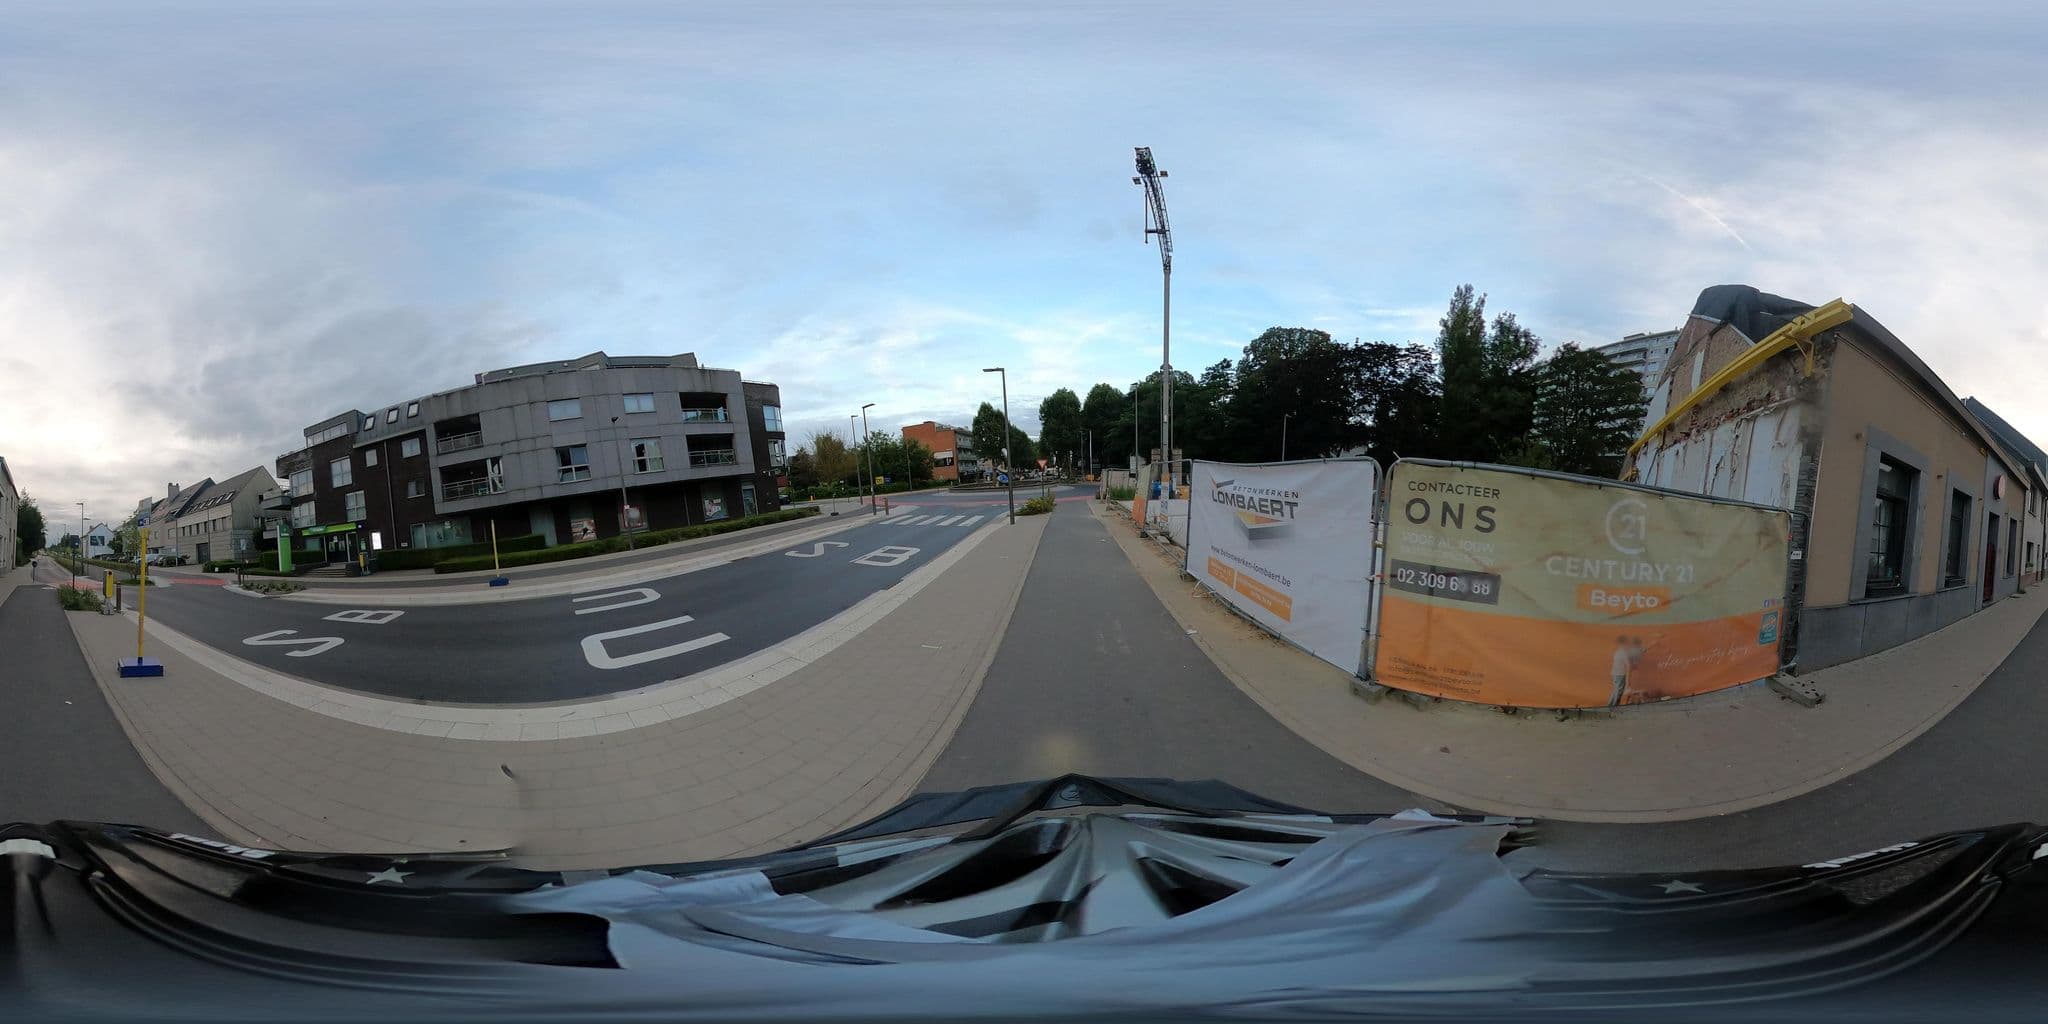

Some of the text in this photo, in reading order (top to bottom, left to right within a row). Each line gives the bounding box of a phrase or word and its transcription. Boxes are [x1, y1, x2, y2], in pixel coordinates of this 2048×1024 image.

[1232, 485, 1299, 498] BETONWERKEN
[1408, 480, 1501, 500] CONTACTEER
[1211, 490, 1298, 519] LOMBAERT
[1405, 497, 1497, 534] ONS
[1397, 568, 1414, 584] 02
[1418, 571, 1446, 589] 309
[1545, 556, 1695, 583] CENTURY 21
[1590, 589, 1659, 611] Beyto
